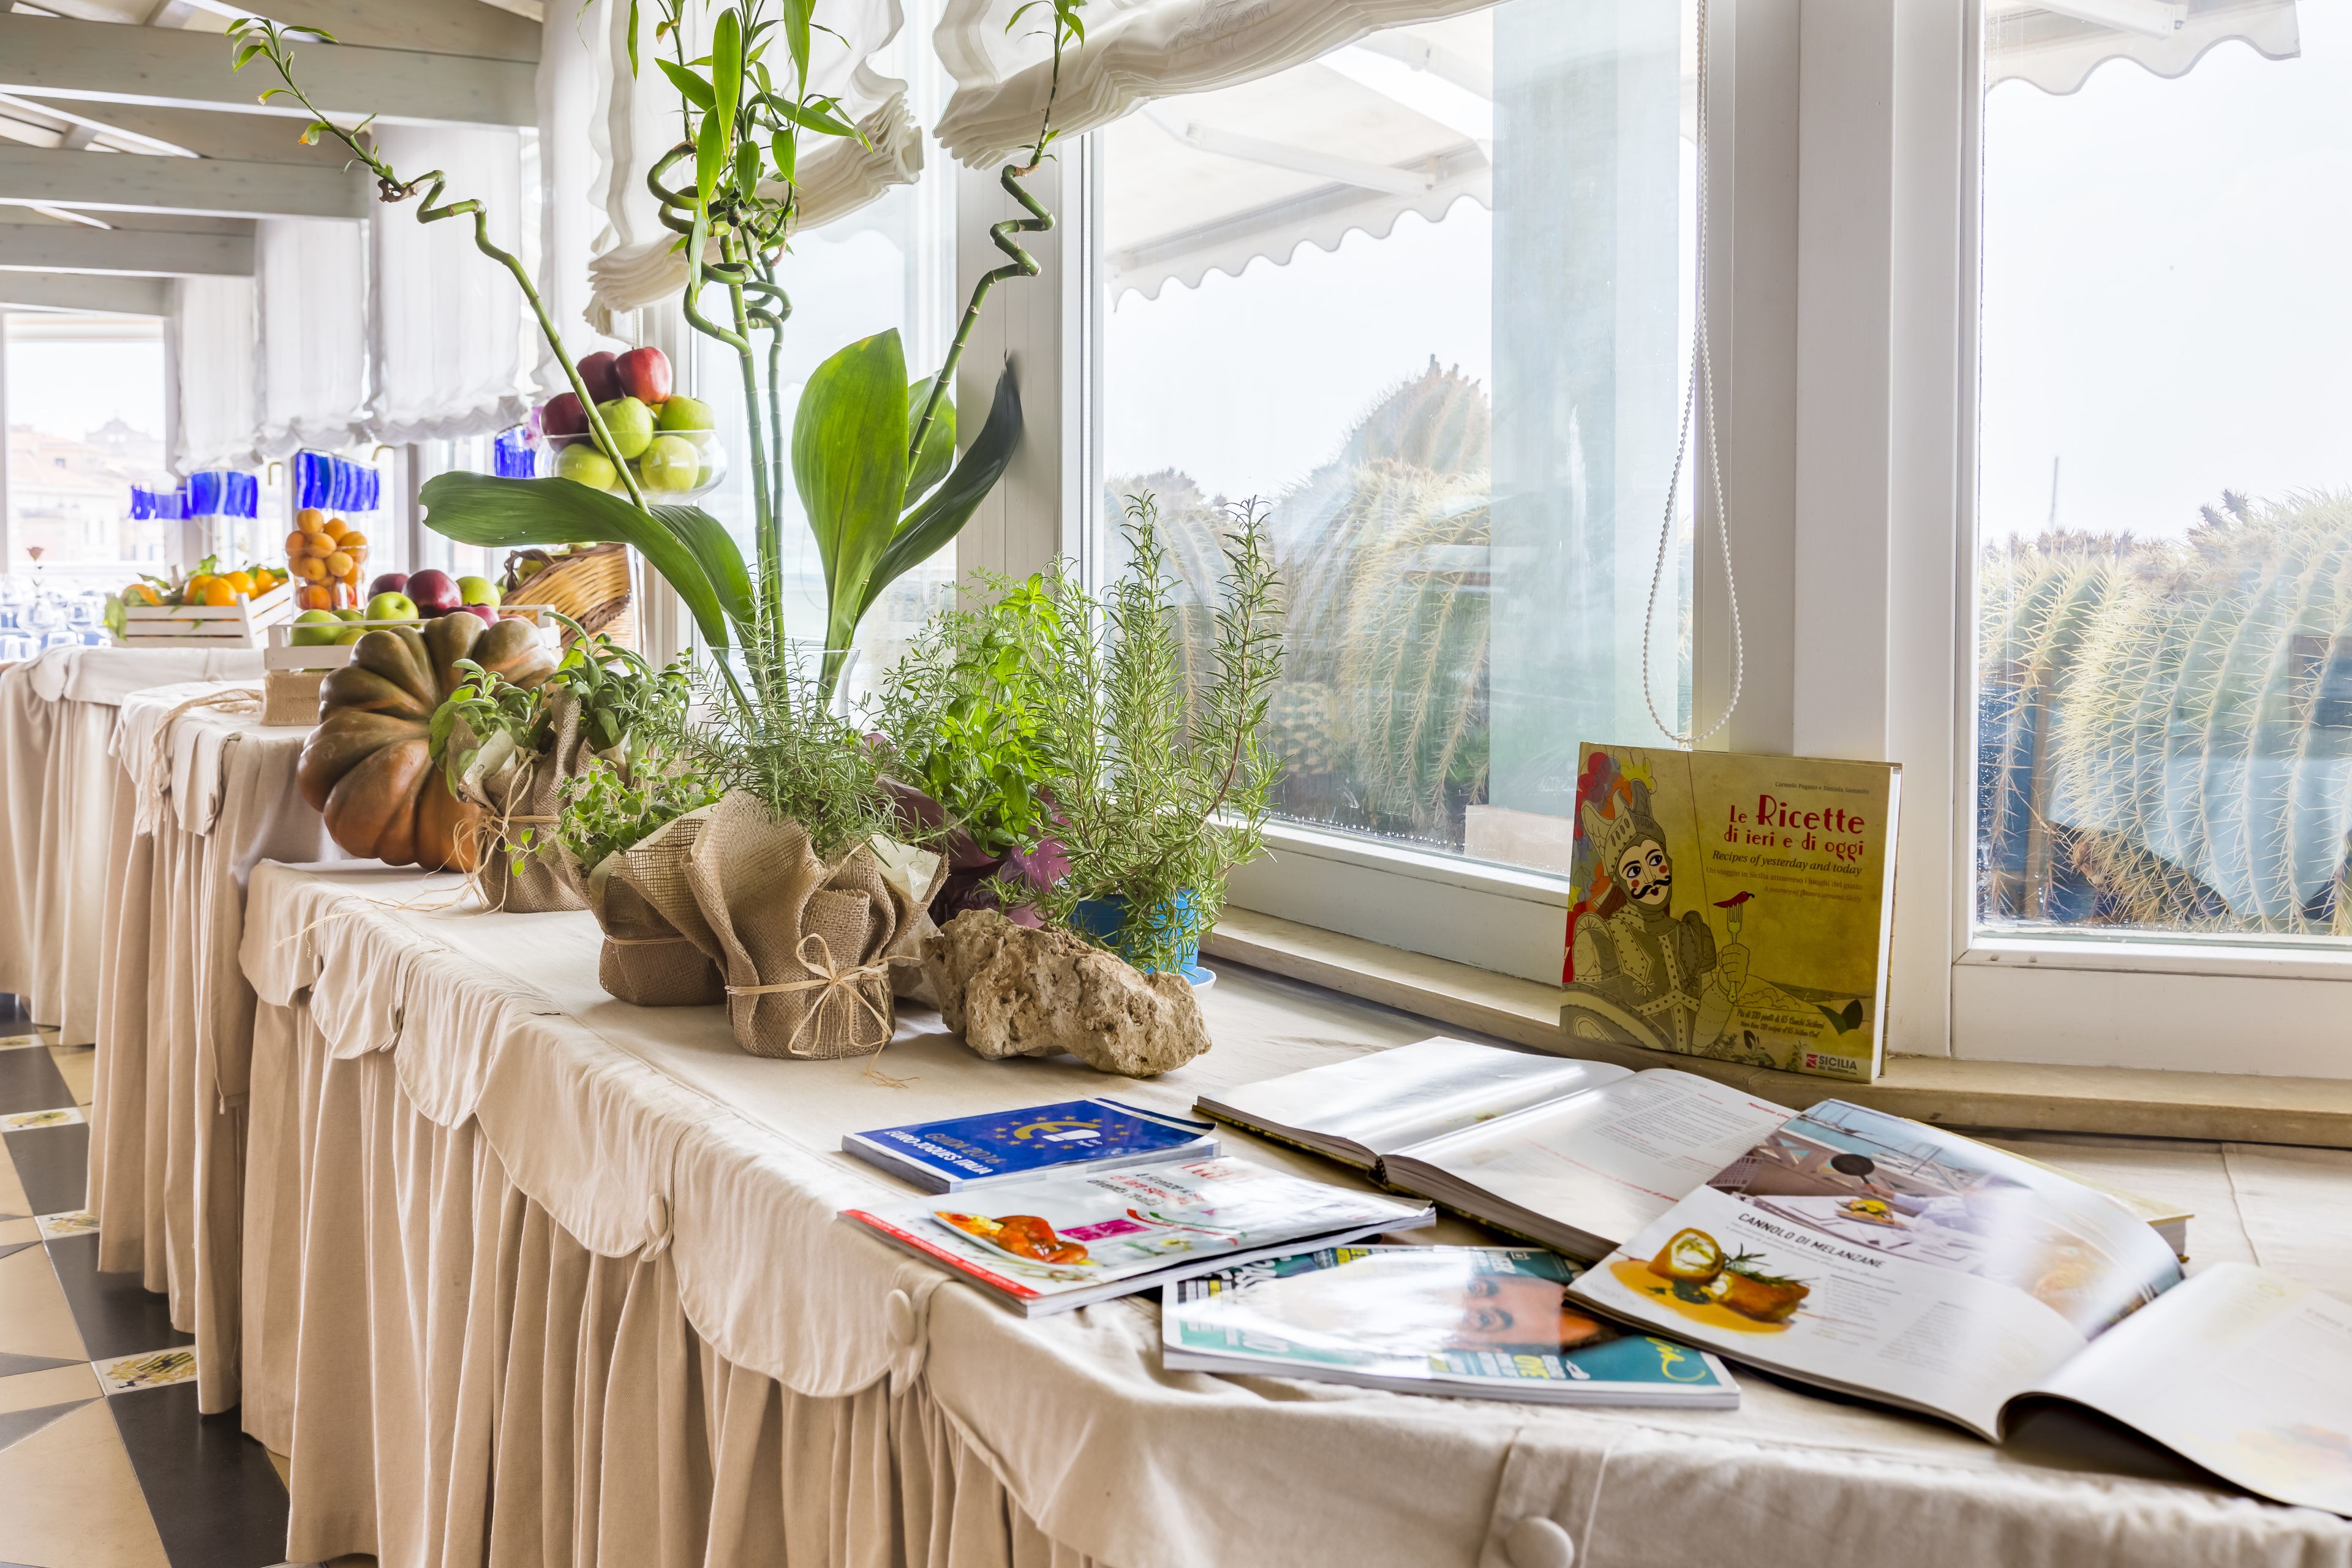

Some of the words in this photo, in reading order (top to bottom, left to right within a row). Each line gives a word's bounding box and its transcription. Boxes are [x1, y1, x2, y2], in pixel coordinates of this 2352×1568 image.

[1730, 805, 1747, 823] Le
[1756, 794, 1865, 834] Ricette
[1724, 824, 1738, 843] di
[1746, 829, 1774, 846] ieri
[1783, 837, 1793, 848] e
[1801, 832, 1816, 850] di
[1825, 840, 1864, 863] oggi
[1712, 850, 1748, 864] Recipes
[1750, 854, 1762, 865] of
[1761, 856, 1808, 872] yesterday
[1809, 861, 1830, 872] and
[1833, 864, 1863, 877] today
[1717, 869, 1740, 877] viaggio
[1749, 871, 1769, 880] Sicilia
[1770, 874, 1803, 883] attraverso
[1809, 878, 1830, 887] luoghi
[1843, 882, 1863, 891] gusto
[1768, 888, 1791, 896] journey
[1821, 891, 1844, 900] around
[1845, 894, 1863, 903] Sicily
[1819, 1055, 1858, 1070] SICILIA
[883, 1130, 963, 1162] EURO-TOQUES
[952, 1158, 994, 1175] ITALIA
[923, 1133, 971, 1150] GUIDA
[960, 1147, 1008, 1164] 2016
[1738, 1213, 1795, 1240] CANNOLO
[1795, 1234, 1811, 1246] DI
[1811, 1240, 1885, 1268] MELANZANE
